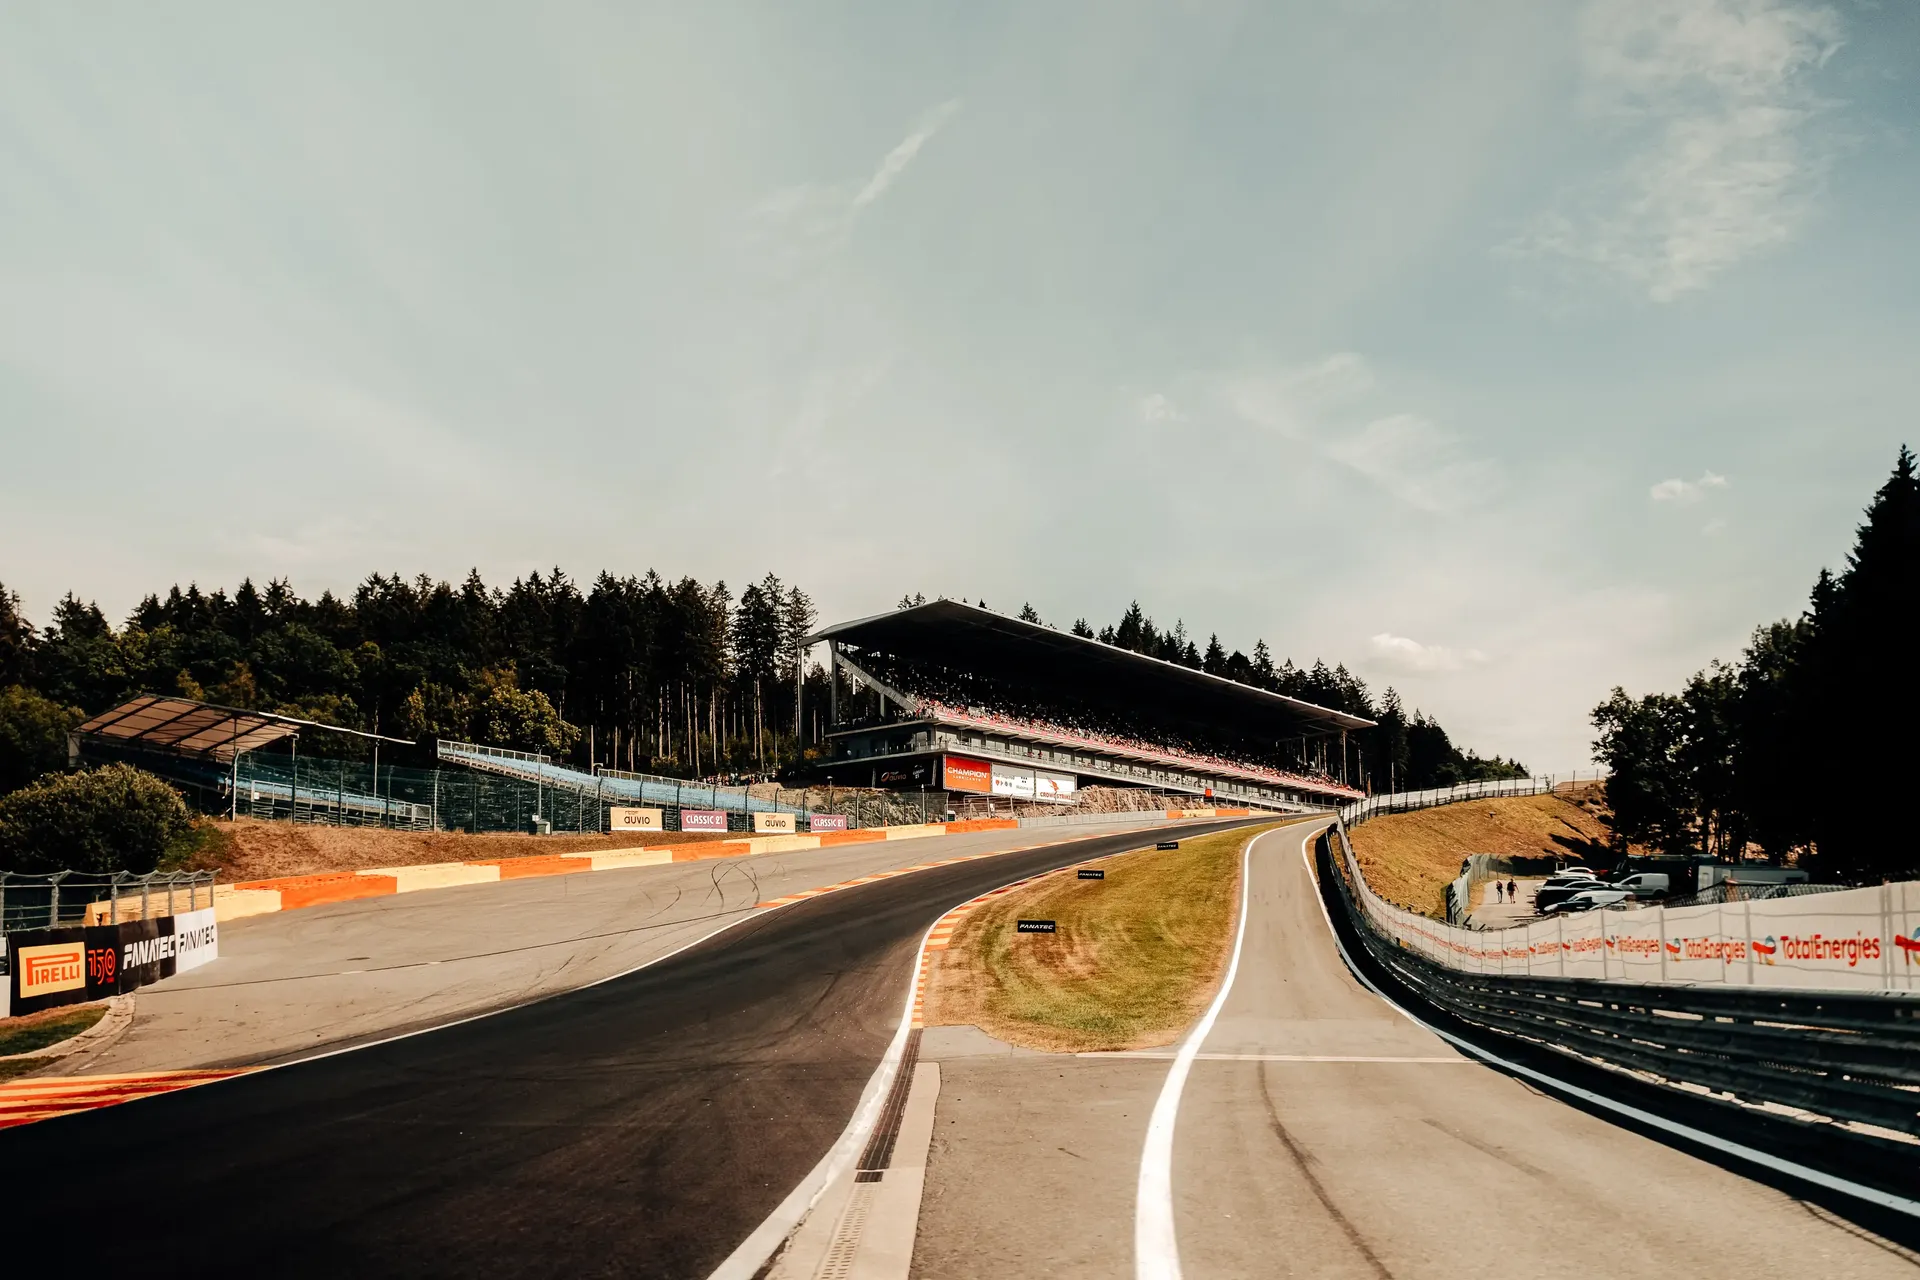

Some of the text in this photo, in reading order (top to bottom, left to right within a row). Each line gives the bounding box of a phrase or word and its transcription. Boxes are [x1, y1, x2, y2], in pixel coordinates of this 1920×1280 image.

[947, 767, 988, 778] CHAMPION
[623, 816, 651, 825] auvio
[685, 815, 723, 825] CLASSIC 21
[764, 819, 786, 828] auvio
[813, 819, 844, 827] CLASSIC 21
[179, 925, 214, 953] FANATEC
[1780, 930, 1881, 967] TotalEnergies
[123, 934, 175, 970] FANATEC
[1683, 936, 1746, 964] TotalEnergies
[26, 952, 80, 986] PIRELLI
